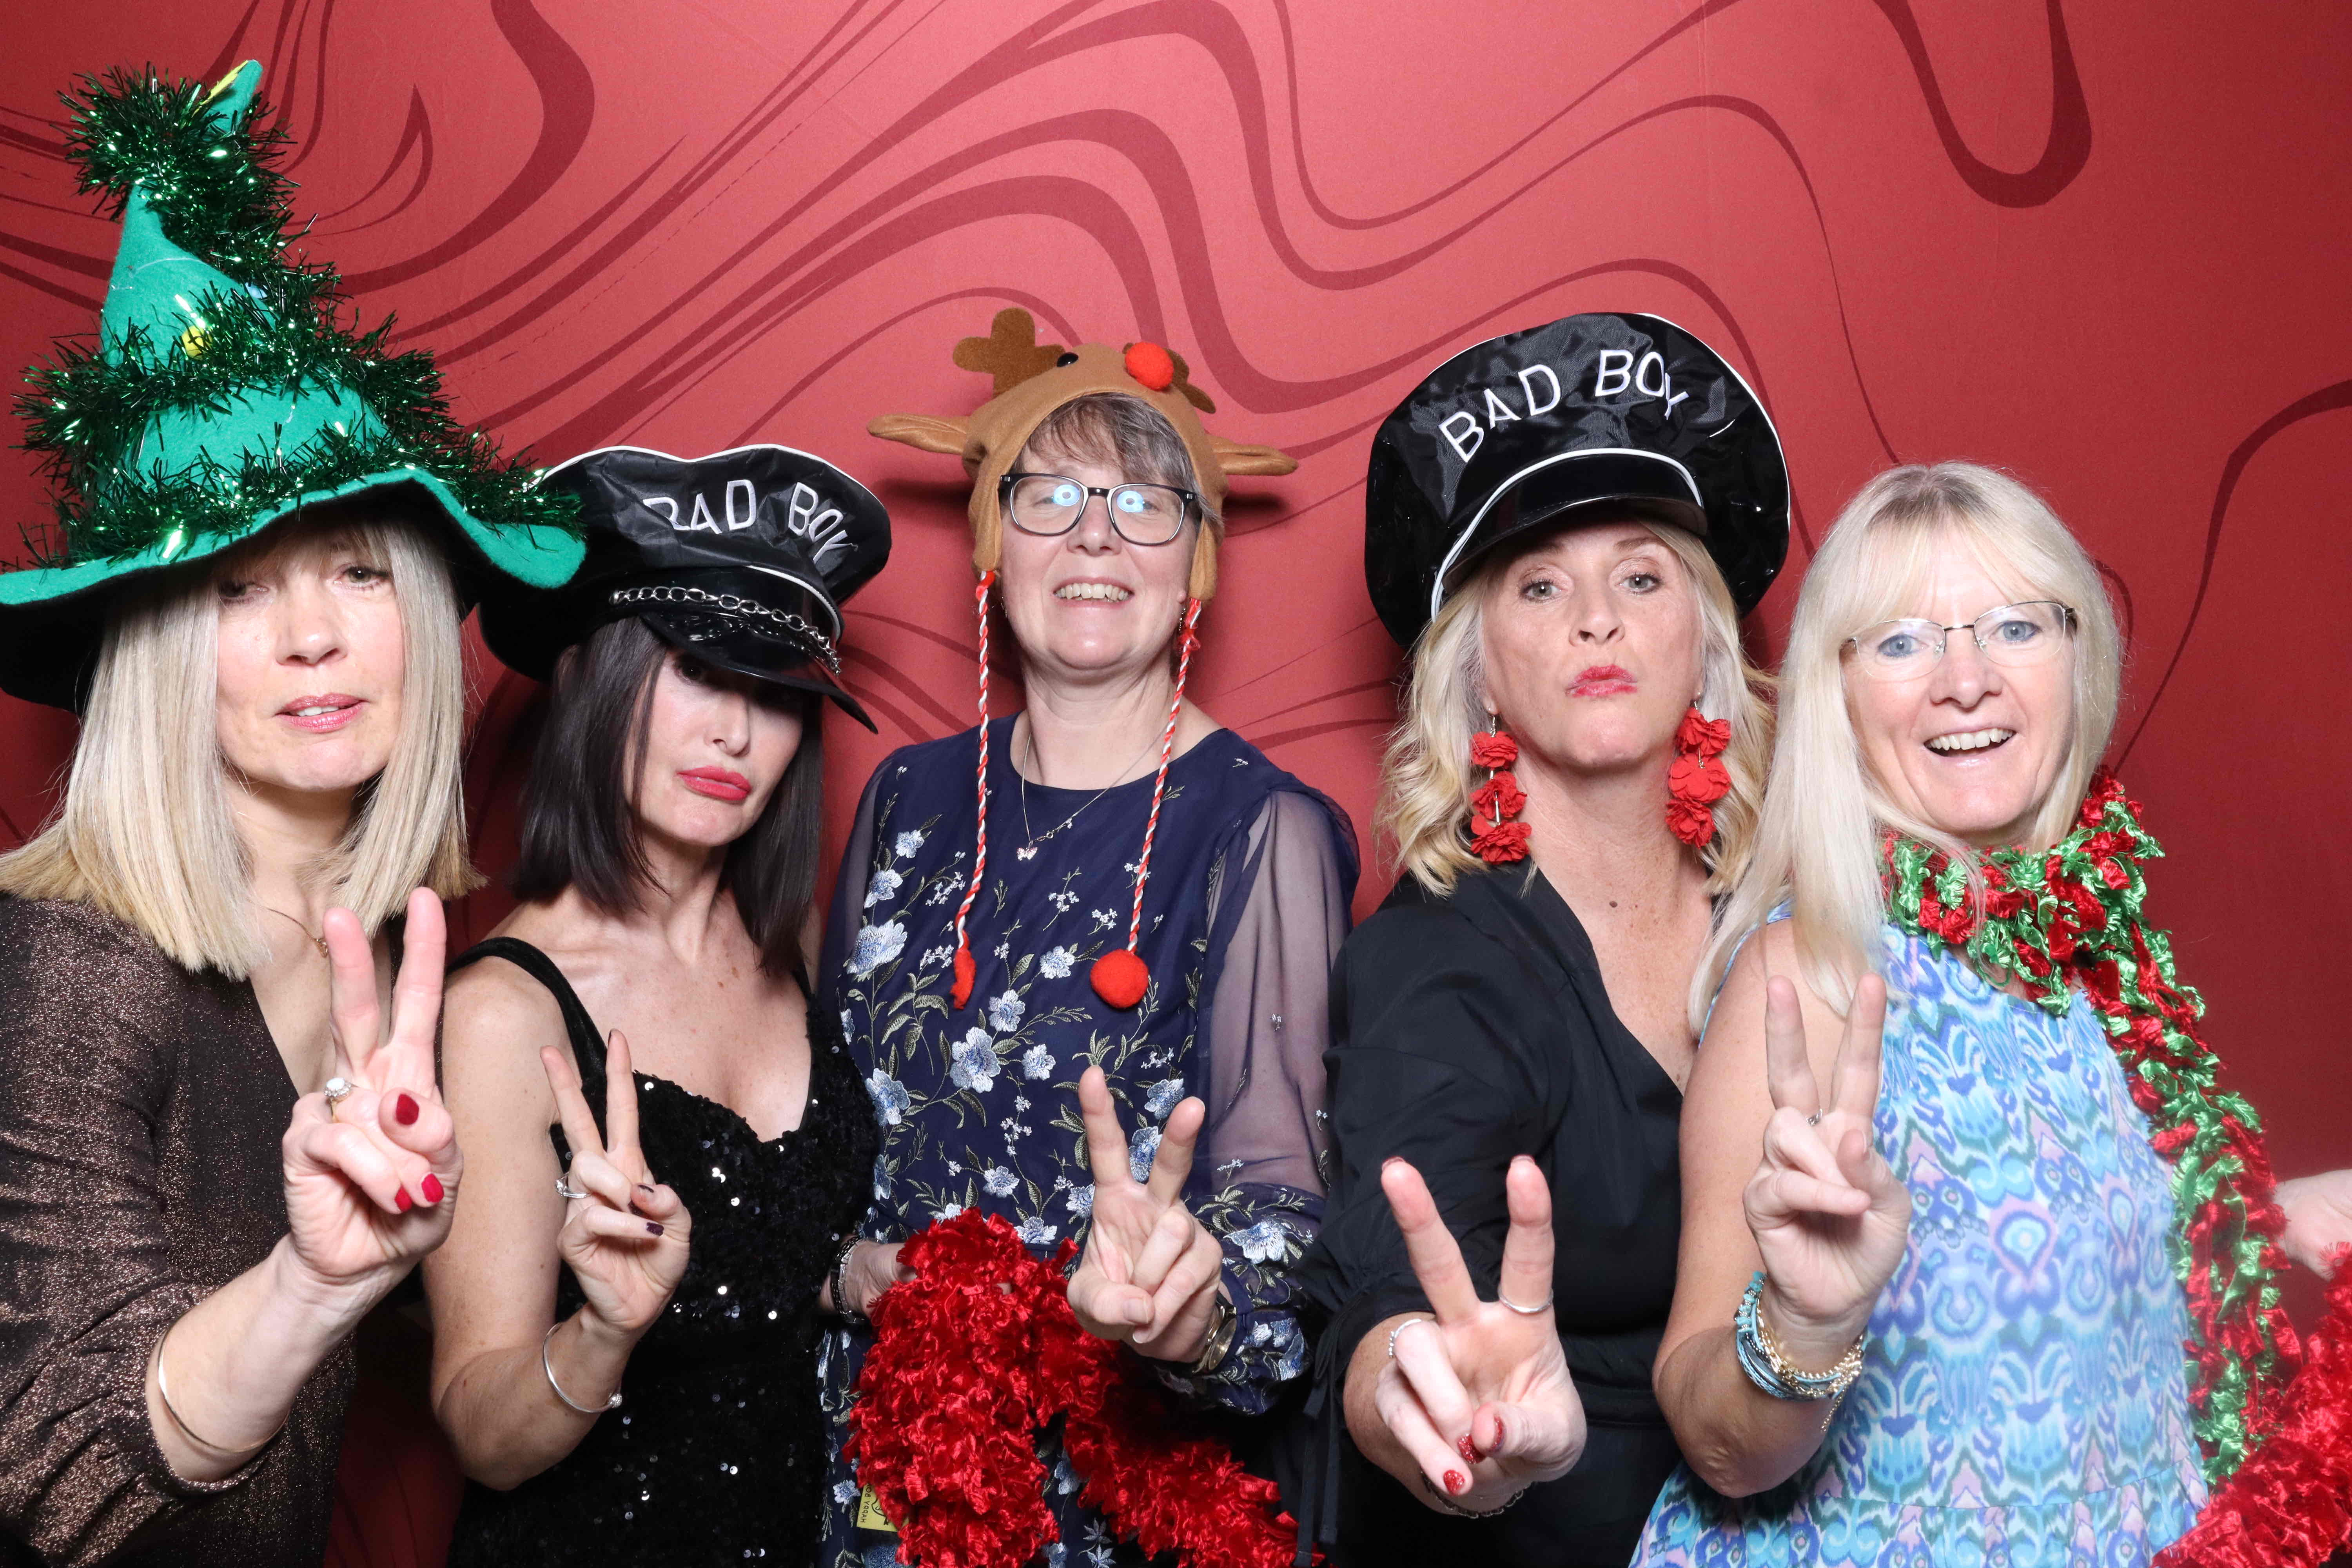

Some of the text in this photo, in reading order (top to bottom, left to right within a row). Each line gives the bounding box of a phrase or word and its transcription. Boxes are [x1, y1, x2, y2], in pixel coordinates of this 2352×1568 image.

[1438, 349, 1689, 463] BAD BOY
[788, 482, 858, 564] BOY
